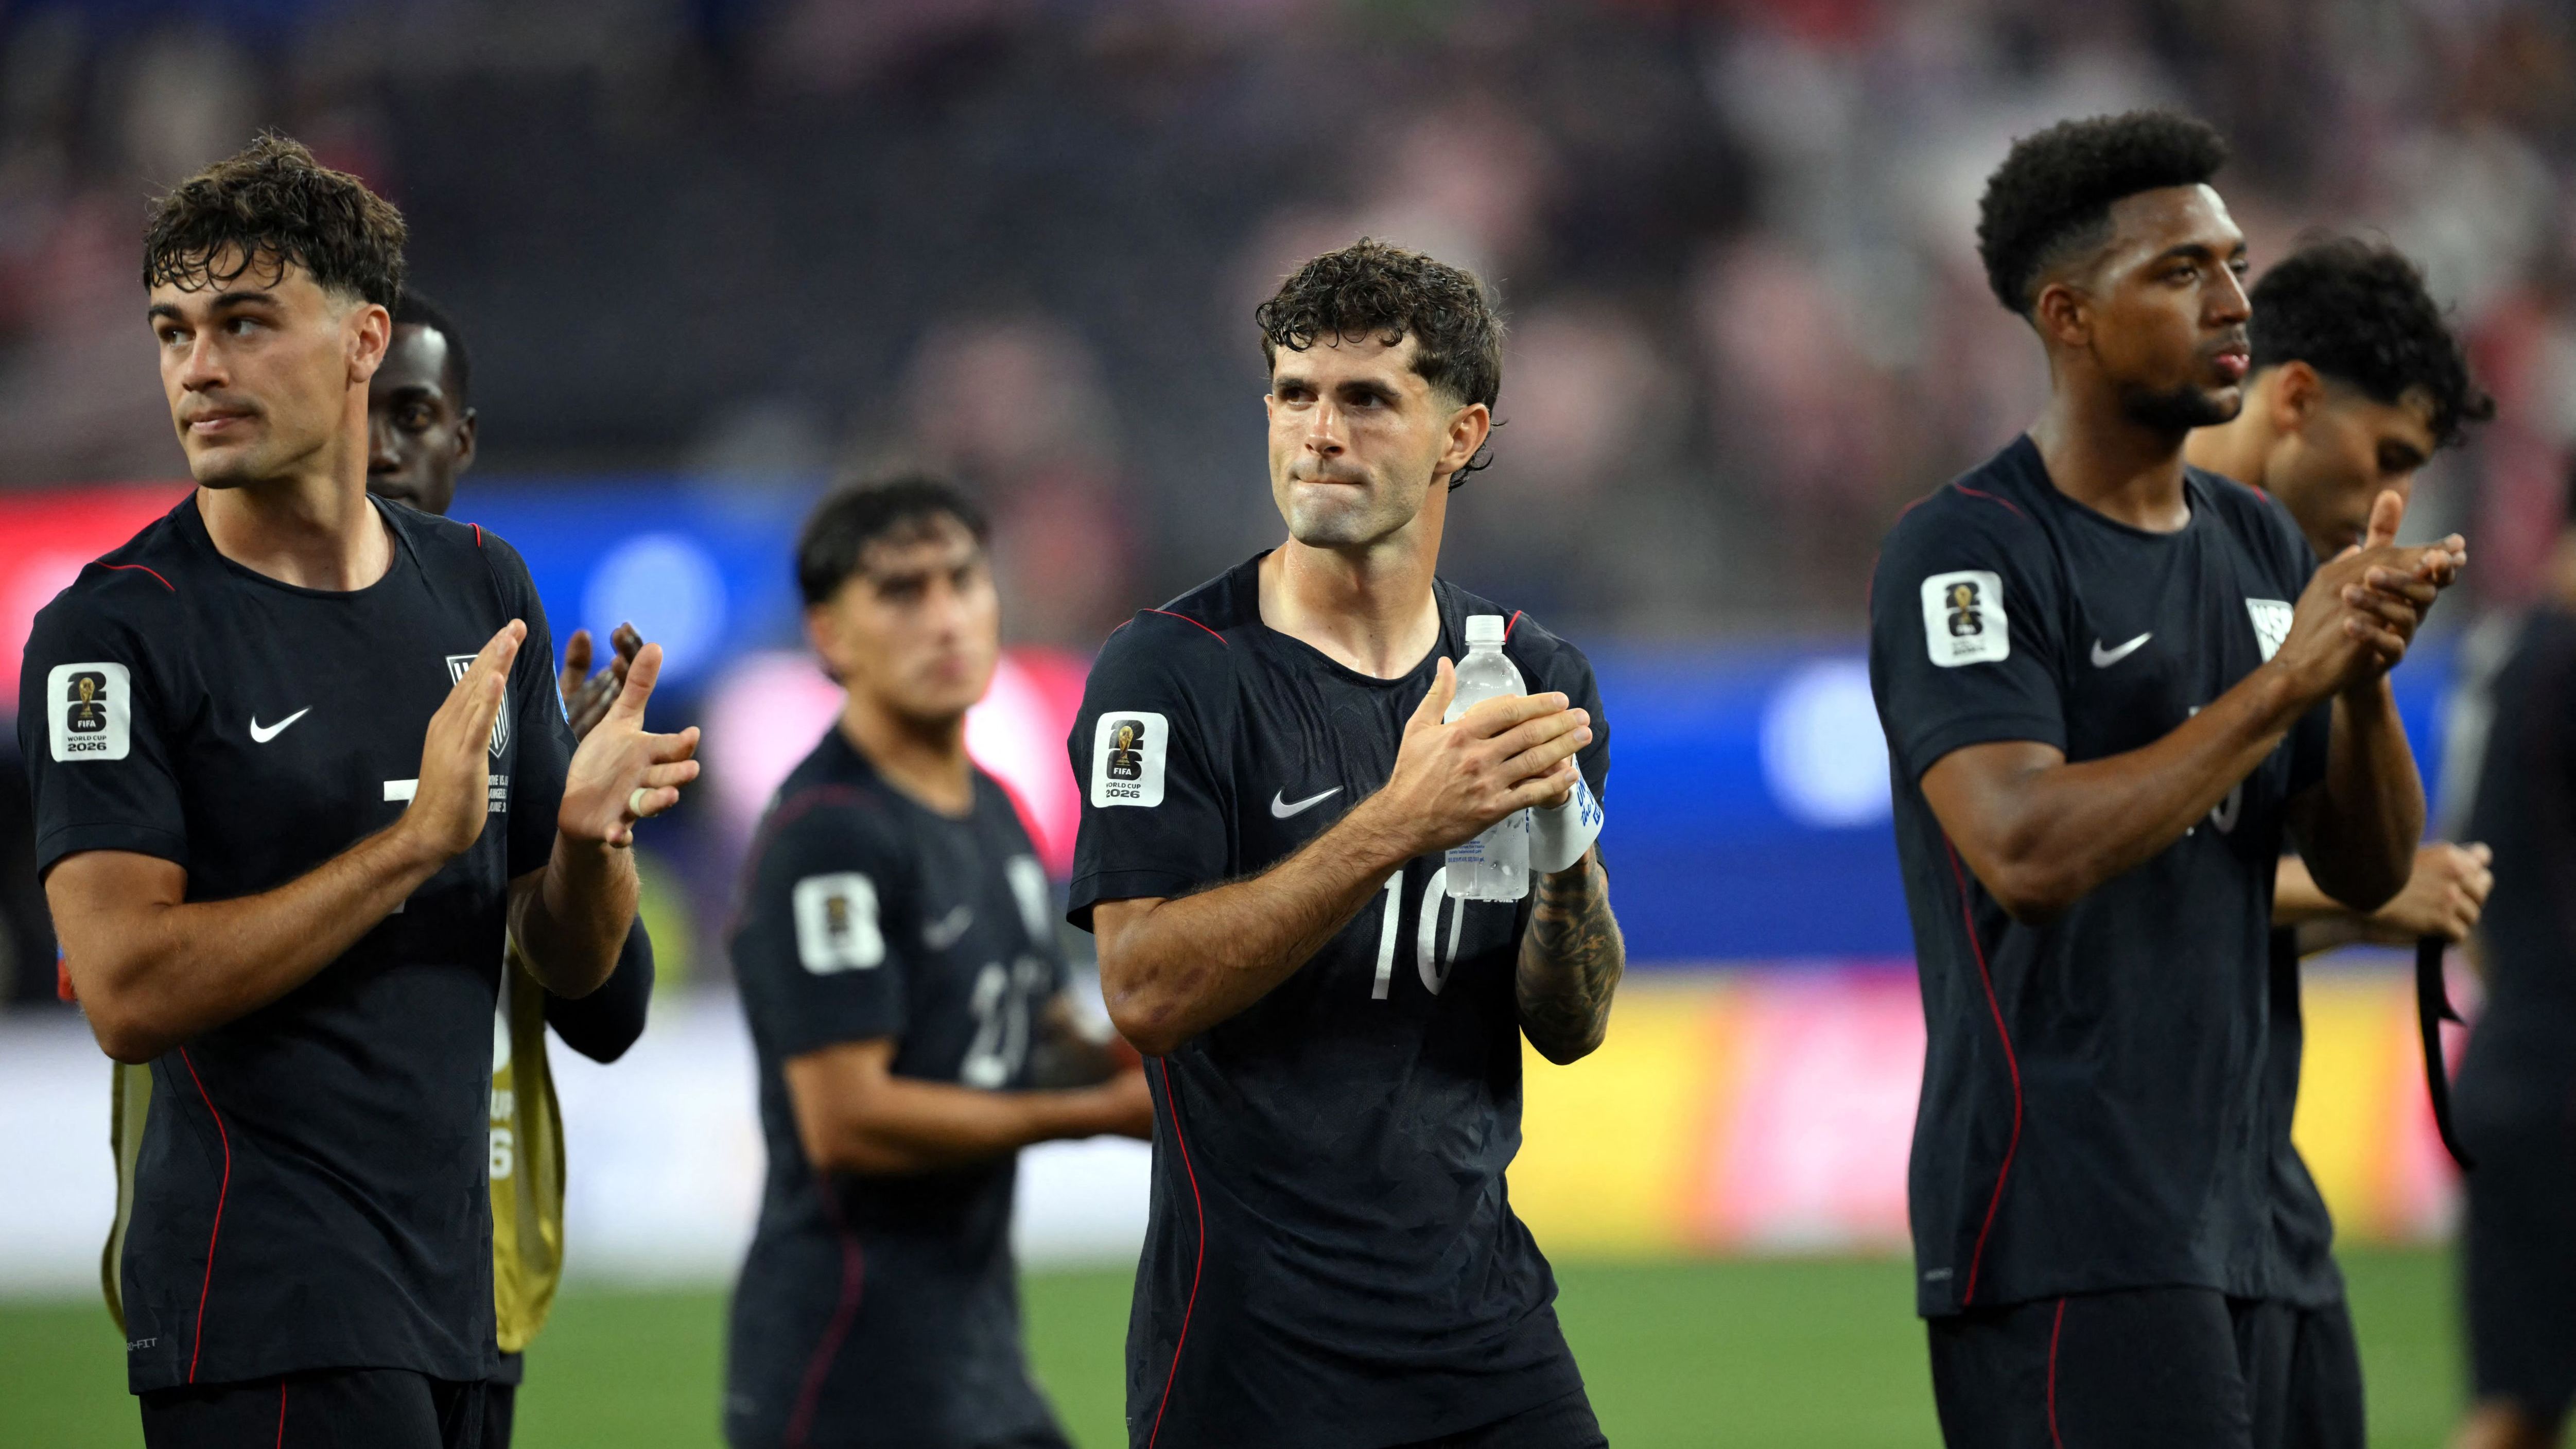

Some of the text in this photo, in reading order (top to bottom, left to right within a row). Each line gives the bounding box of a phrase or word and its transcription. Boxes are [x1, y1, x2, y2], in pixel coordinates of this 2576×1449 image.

[78, 720, 96, 728] FIFA
[67, 742, 107, 752] 2026
[1106, 789, 1140, 798] 2026
[1371, 866, 1465, 1000] 10
